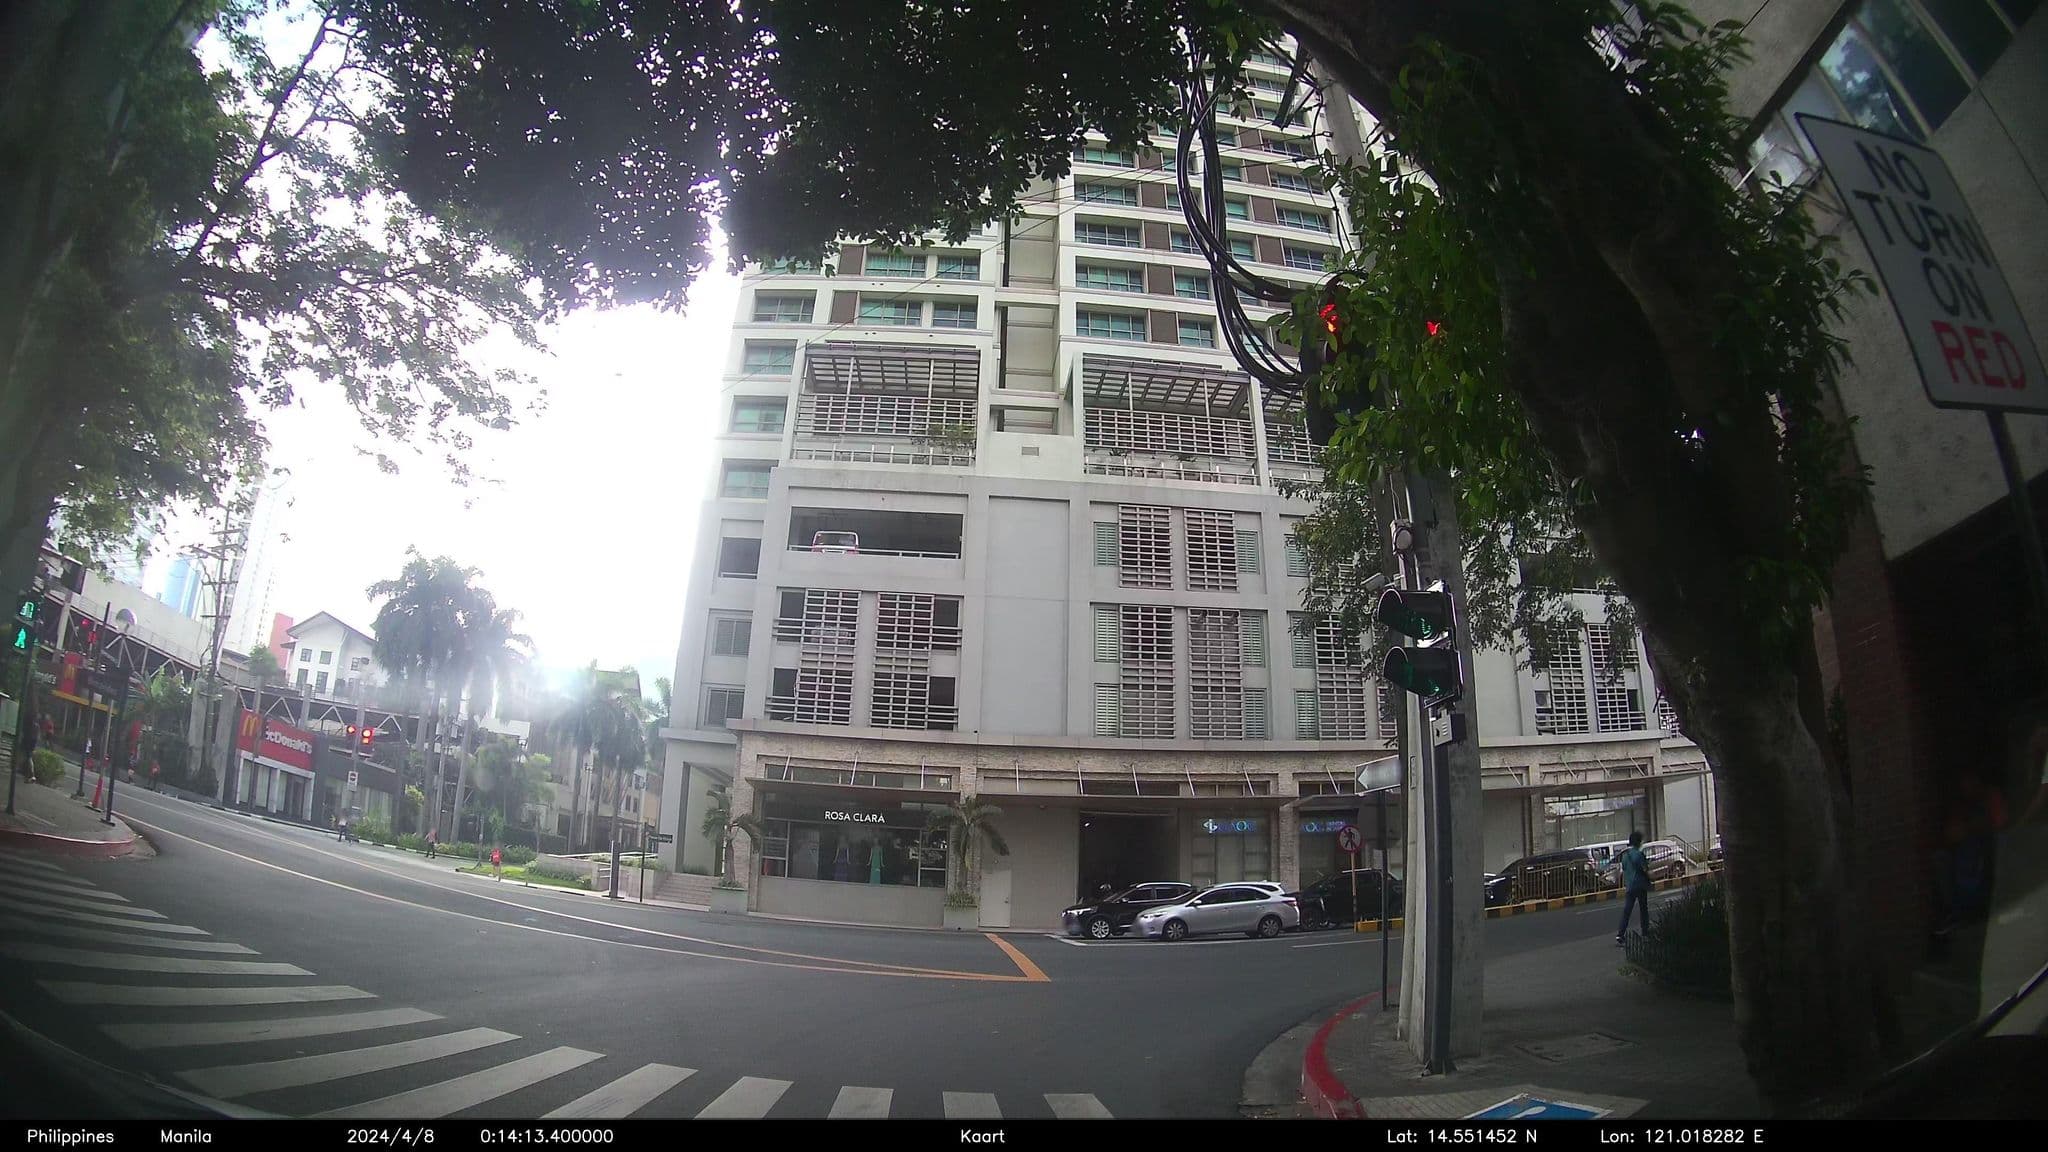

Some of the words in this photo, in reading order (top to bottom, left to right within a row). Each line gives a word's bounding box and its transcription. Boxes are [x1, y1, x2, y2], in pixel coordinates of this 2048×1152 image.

[1854, 139, 1931, 201] NO
[1853, 189, 1991, 269] TURN
[1922, 257, 1994, 322] ON
[1931, 320, 2027, 389] RED
[824, 810, 851, 821] ROSA
